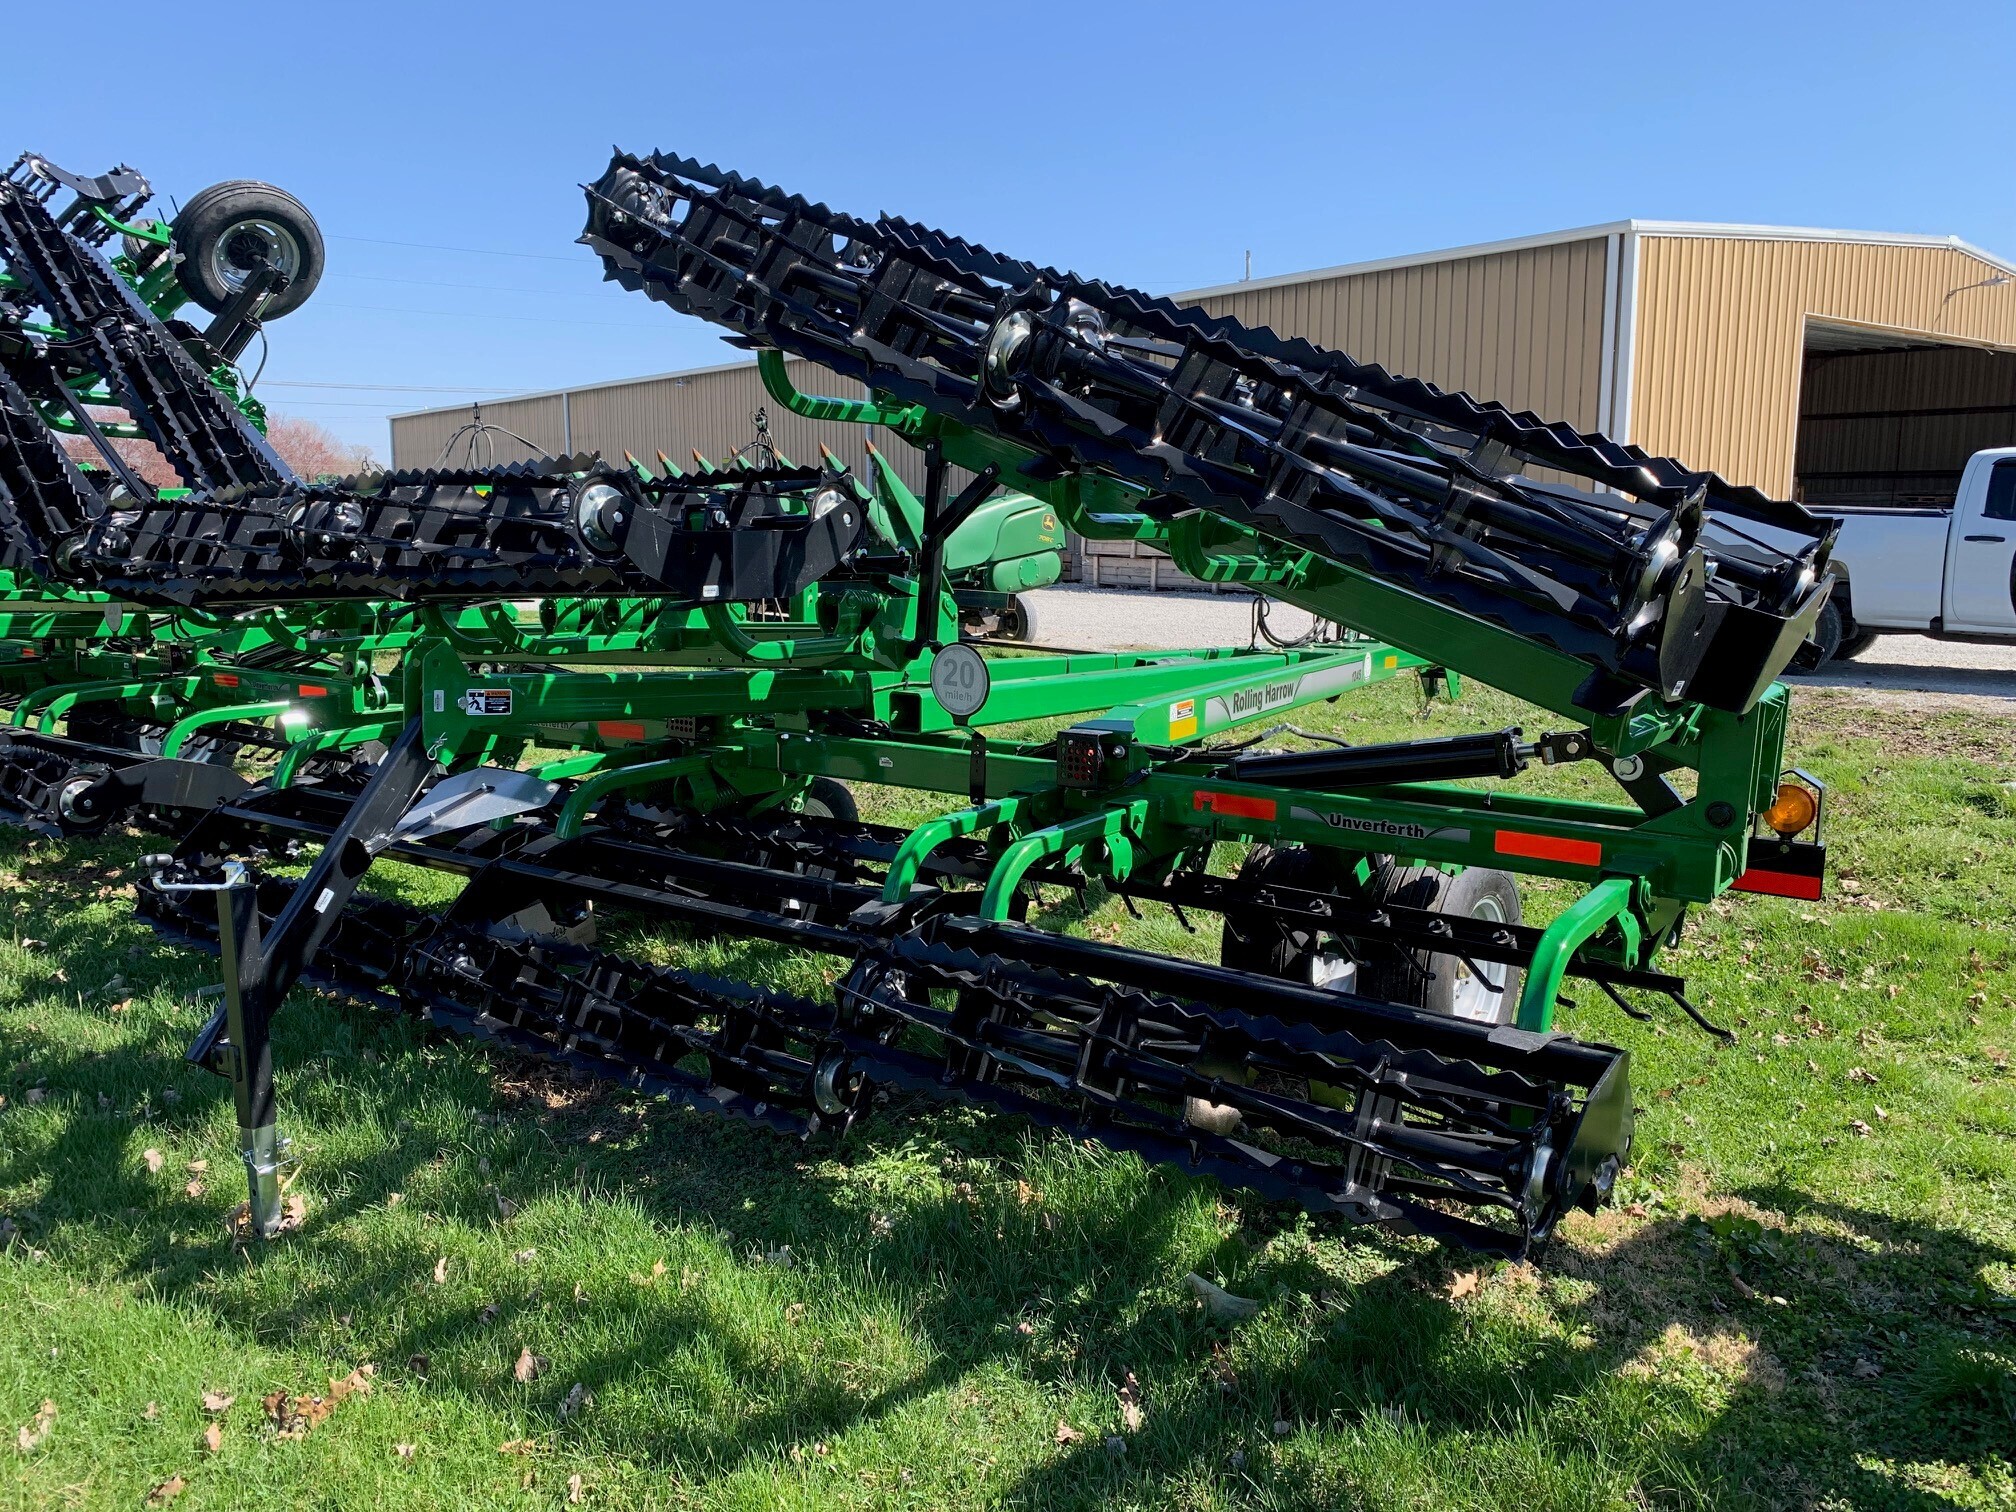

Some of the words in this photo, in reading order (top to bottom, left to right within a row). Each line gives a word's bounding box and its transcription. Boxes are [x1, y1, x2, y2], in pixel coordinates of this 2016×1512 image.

[942, 658, 975, 690] 20
[945, 690, 973, 702] mile/h
[1233, 689, 1263, 713] Rolling
[1265, 683, 1294, 704] Harrow
[1329, 813, 1424, 838] Unverferth
